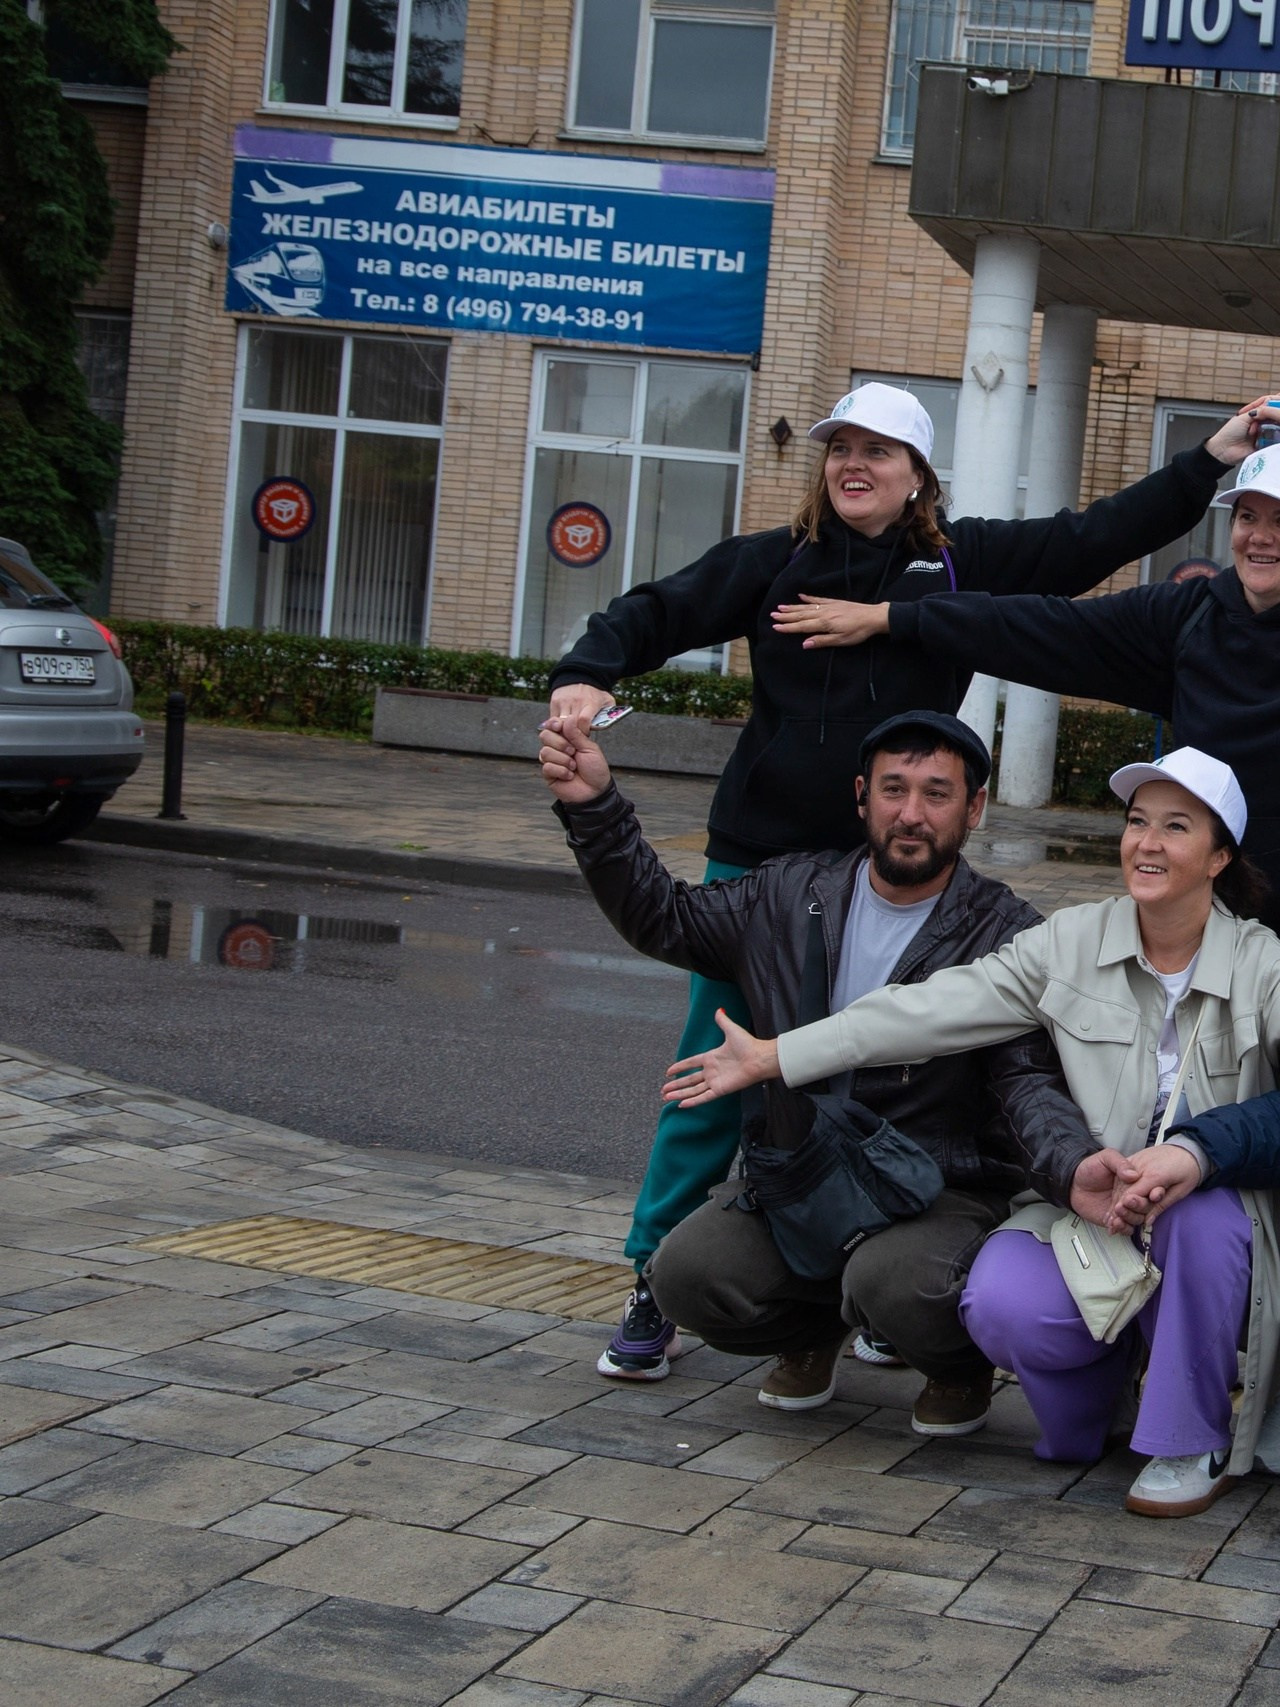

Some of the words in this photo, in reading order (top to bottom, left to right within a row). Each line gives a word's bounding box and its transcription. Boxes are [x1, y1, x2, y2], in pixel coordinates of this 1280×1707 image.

[394, 190, 616, 230] АВИАБИЛЕТЫ
[262, 213, 603, 263] ЖЕЛЕЗНОДОРОЖНЫЕ
[611, 241, 746, 274] БИЛЕТЫ
[357, 258, 391, 276] на
[400, 261, 449, 281] все
[457, 266, 645, 297] направления
[350, 288, 415, 313] Тел.:
[422, 294, 439, 315] 8
[446, 296, 512, 325] (496)
[520, 302, 644, 332] 794-38-91
